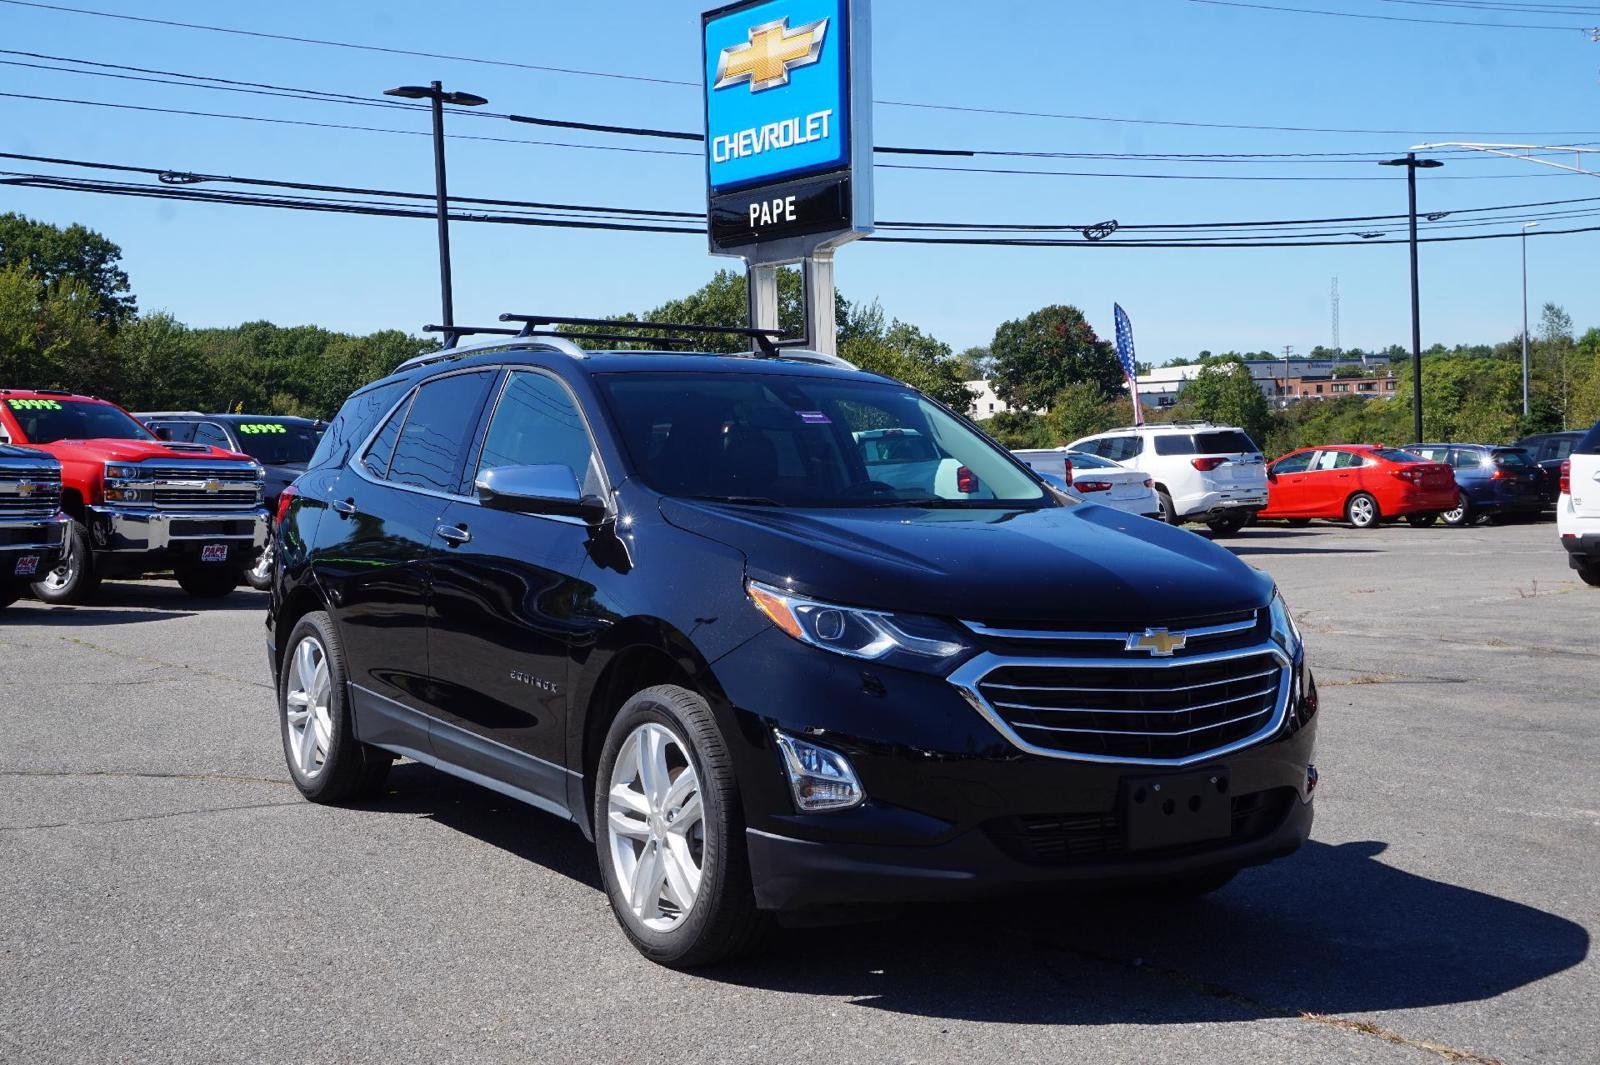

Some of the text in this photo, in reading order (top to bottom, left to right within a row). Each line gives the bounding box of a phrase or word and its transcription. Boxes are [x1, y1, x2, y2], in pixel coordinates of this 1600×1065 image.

[713, 109, 832, 163] CHEVROLET
[749, 196, 797, 228] PAPE
[8, 399, 63, 410] 39995
[240, 423, 287, 434] 43995
